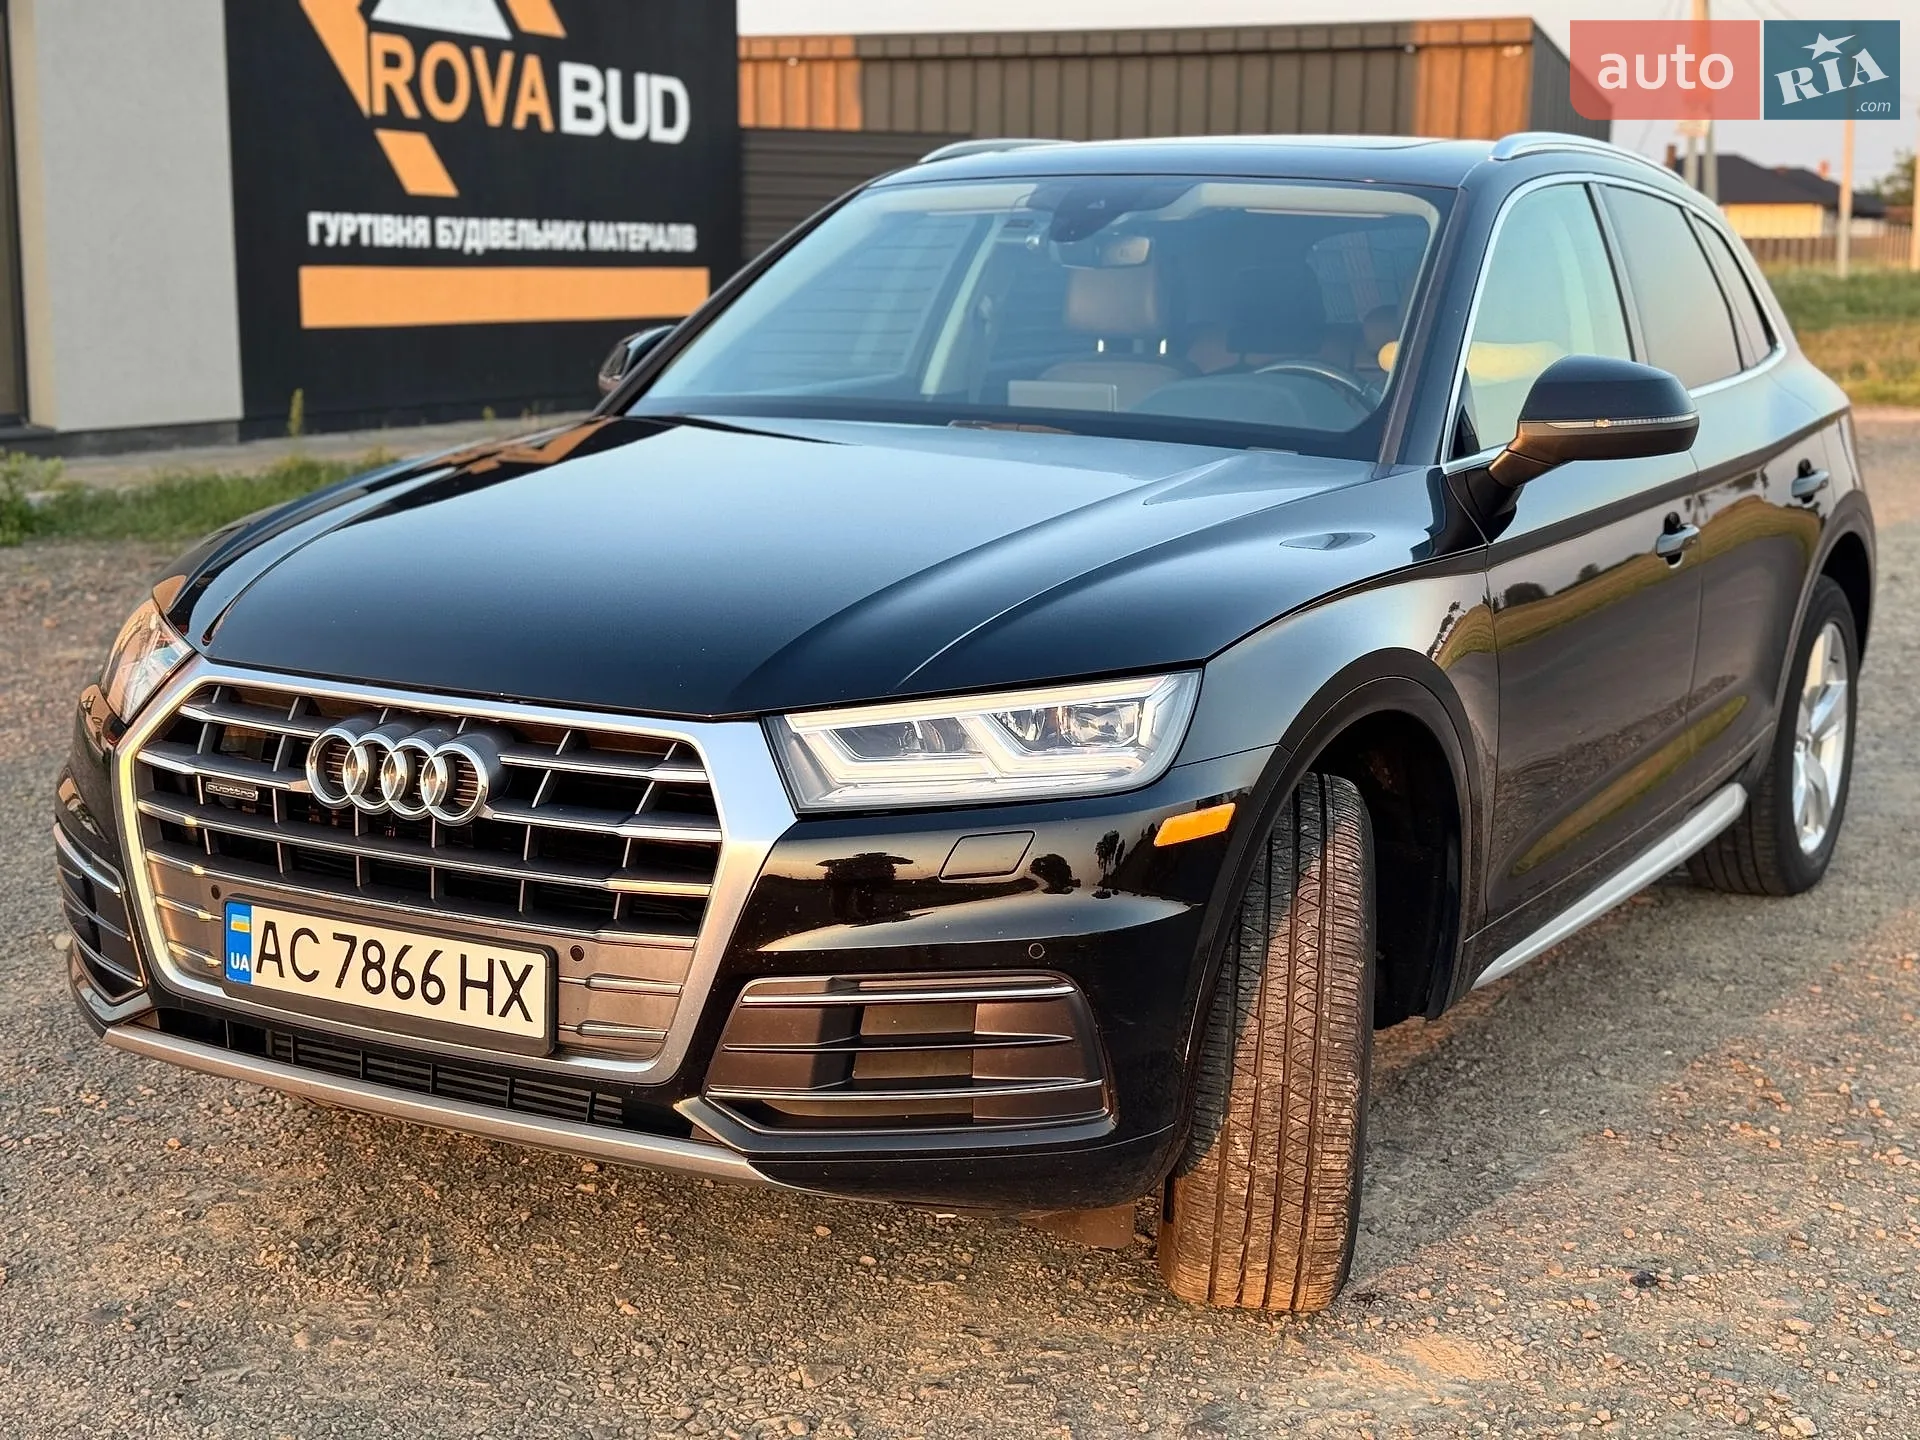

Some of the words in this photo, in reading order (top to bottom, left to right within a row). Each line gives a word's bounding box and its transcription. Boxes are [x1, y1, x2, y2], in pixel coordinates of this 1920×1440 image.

[307, 212, 431, 249] ГУРТІВНЯ
[436, 218, 586, 255] БУДІВЕЛЬНИХ
[588, 222, 697, 252] МАТЕРІАЛІВ
[230, 951, 251, 972] UA
[255, 919, 321, 984] AC
[332, 932, 447, 1006] 7866
[458, 953, 534, 1023] HX
